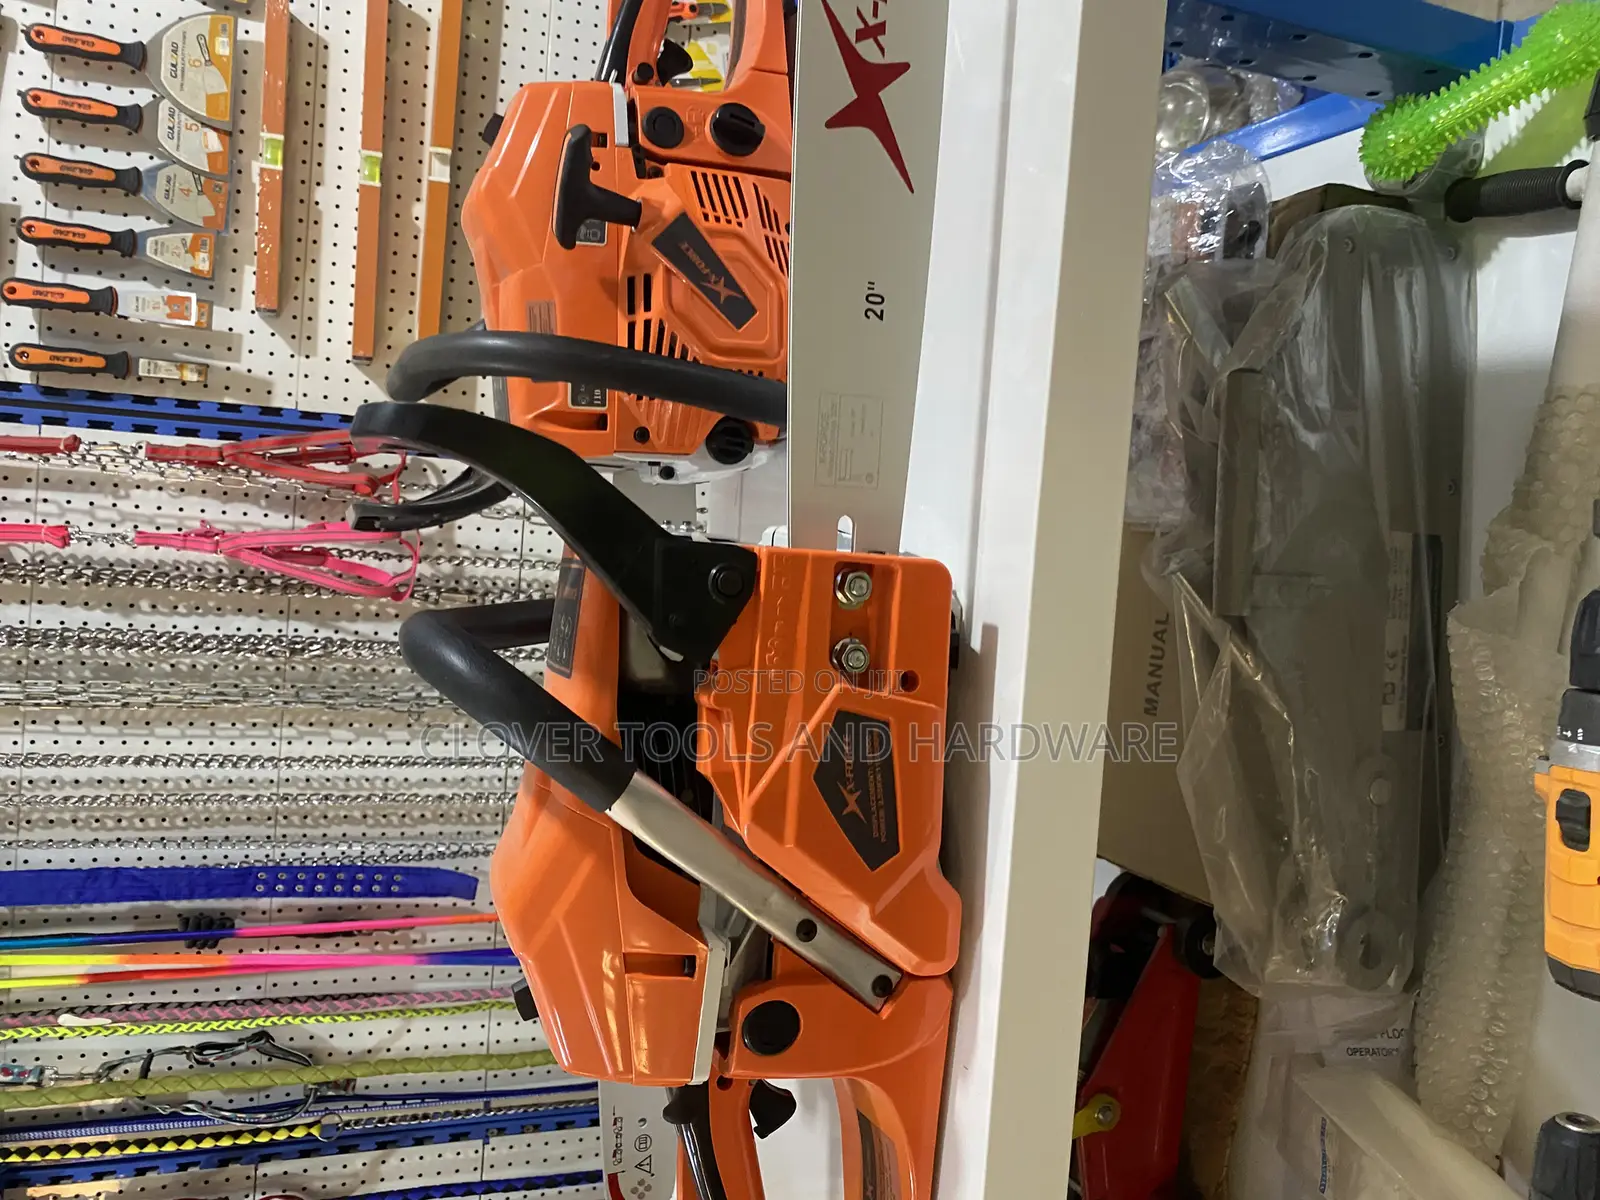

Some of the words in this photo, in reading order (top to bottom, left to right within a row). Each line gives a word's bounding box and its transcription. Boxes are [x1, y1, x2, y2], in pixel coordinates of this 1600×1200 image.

[854, 0, 887, 59] X-
[864, 281, 885, 322] 20"
[1143, 612, 1170, 717] MANUAL
